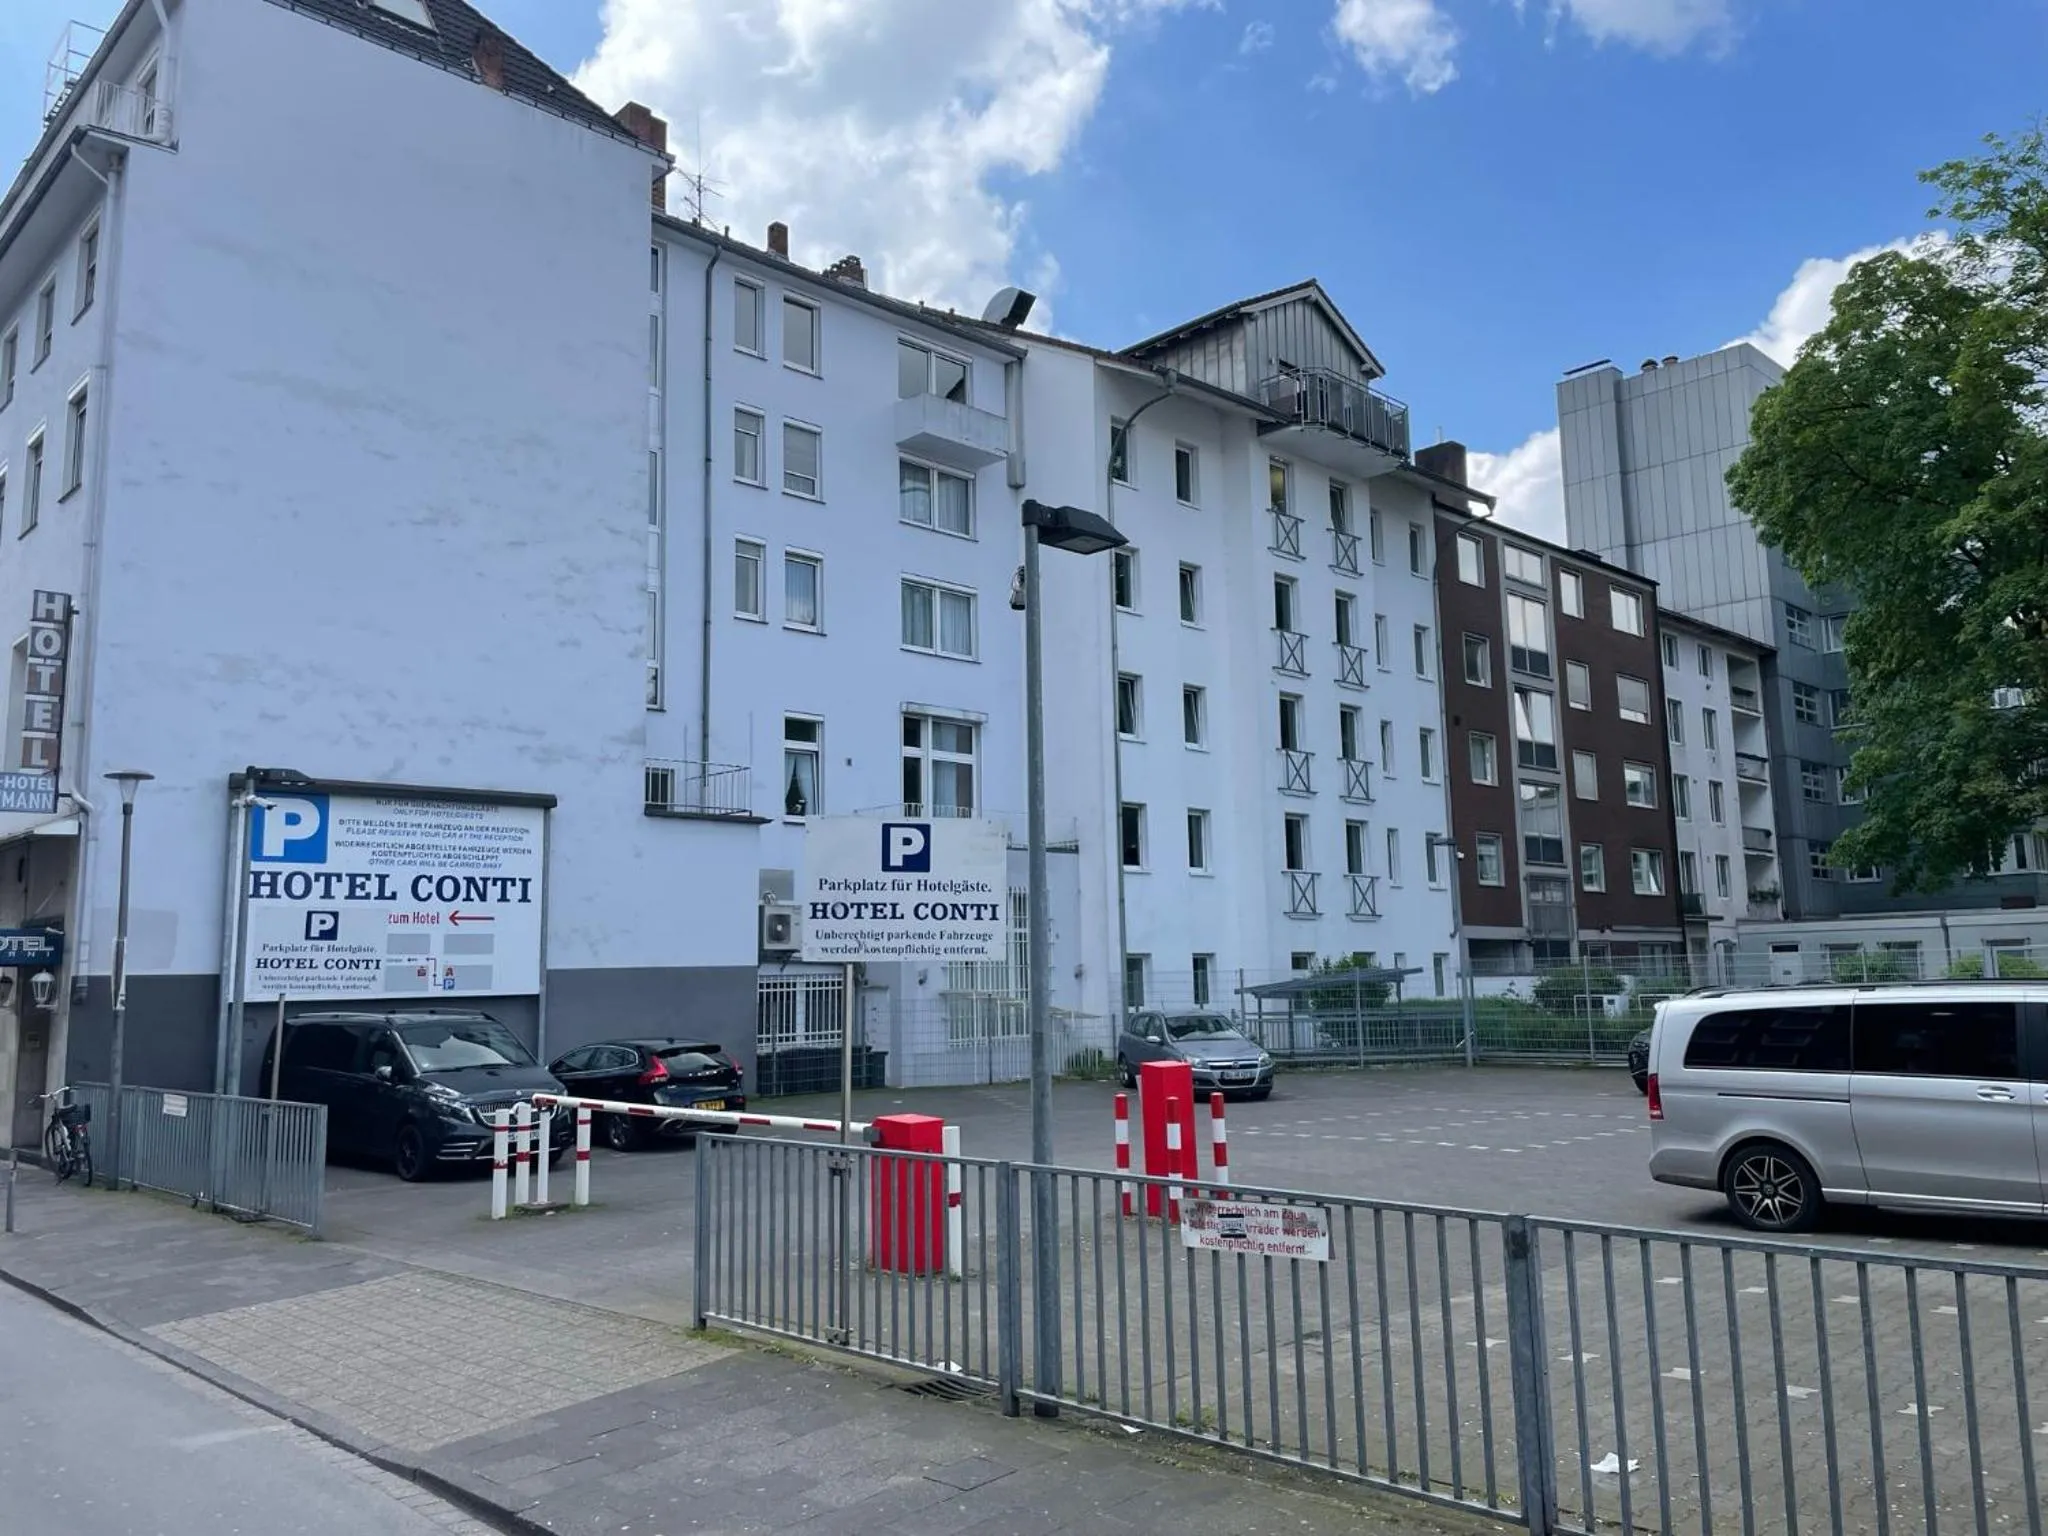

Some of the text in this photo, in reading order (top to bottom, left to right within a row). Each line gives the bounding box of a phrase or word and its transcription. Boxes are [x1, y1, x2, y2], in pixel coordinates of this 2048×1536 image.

[31, 592, 64, 767] HOTEL
[263, 797, 321, 857] P
[362, 819, 395, 828] MELDEN
[889, 827, 925, 867] P
[249, 870, 532, 903] HOTEL CONTI
[818, 878, 993, 895] Parkplatz für Hotelgäste.
[388, 911, 440, 925] zum Hotel
[808, 902, 1000, 921] HOTEL CONTI
[310, 912, 335, 938] P
[815, 929, 993, 942] Unberechtigt parkende Fahrzeuge
[821, 943, 989, 956] werden kostenpflichtig entfernt.
[255, 957, 319, 969] HOTEL
[324, 958, 382, 970] CONTI
[1264, 1208, 1279, 1219] am
